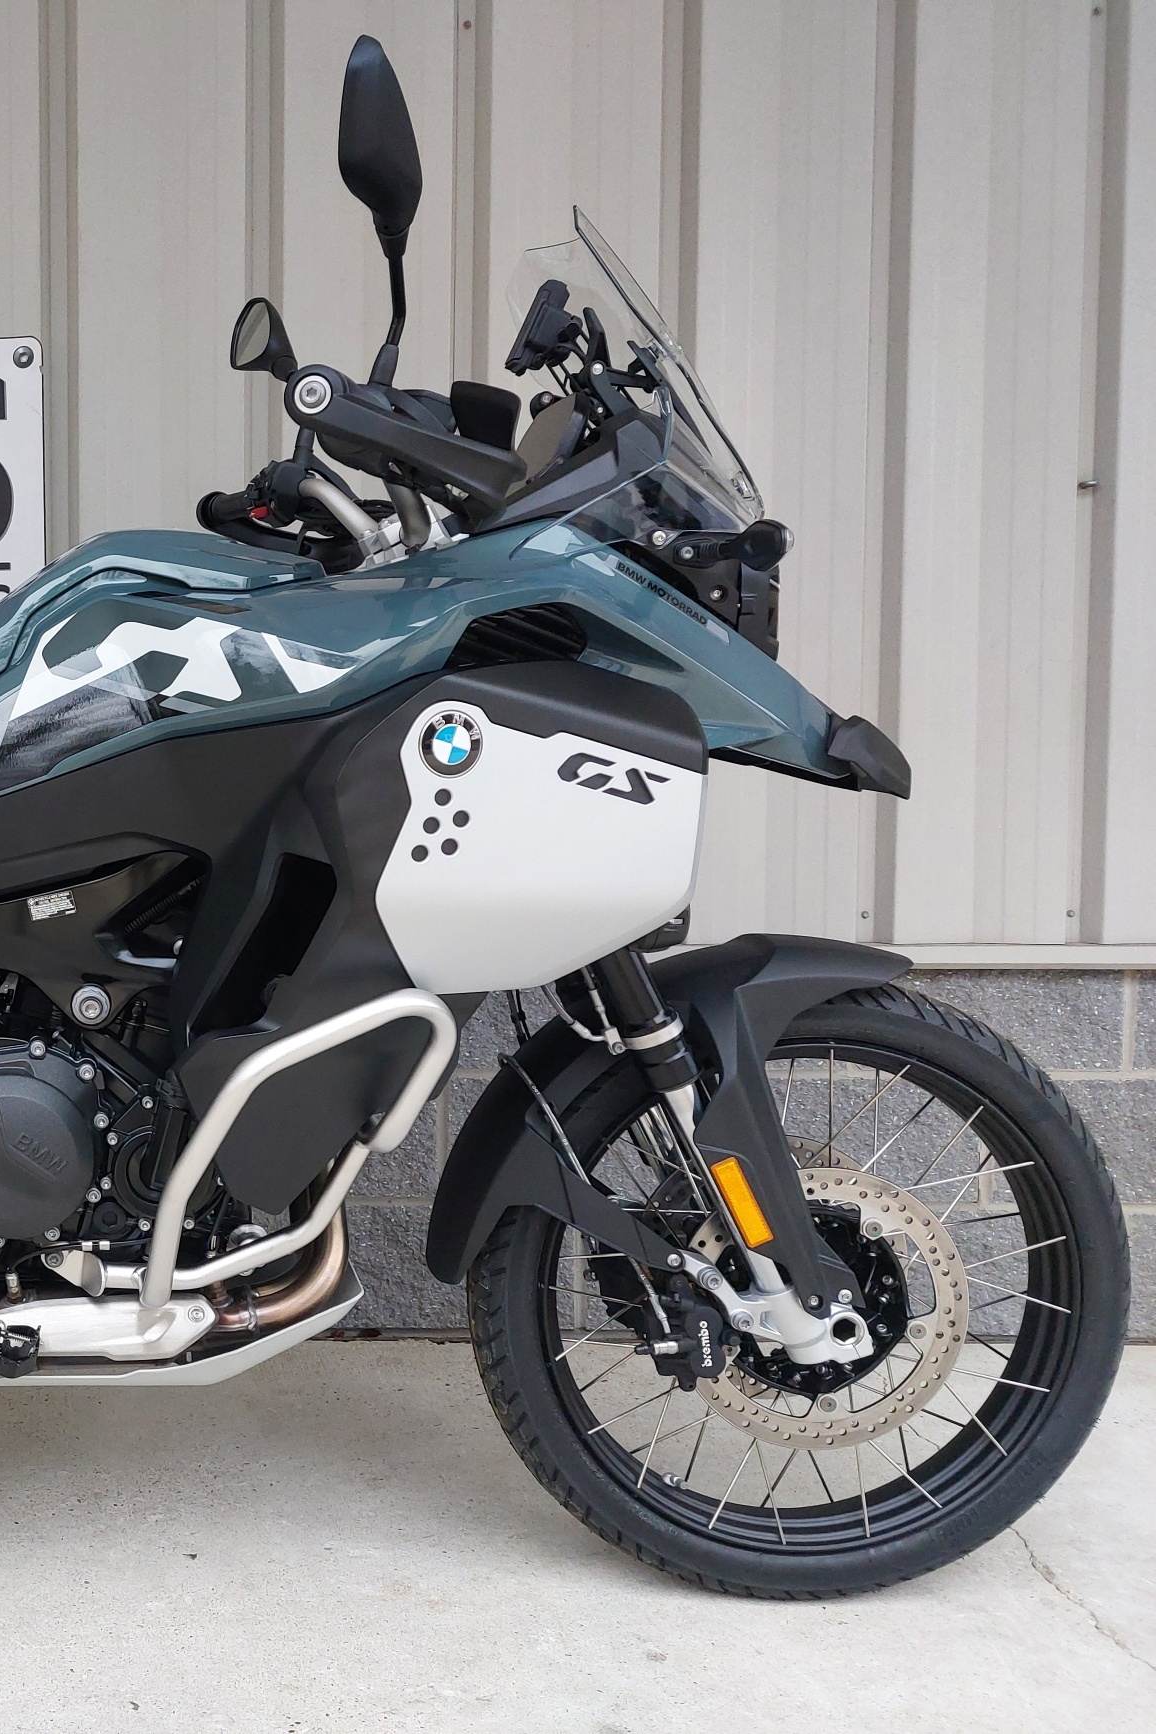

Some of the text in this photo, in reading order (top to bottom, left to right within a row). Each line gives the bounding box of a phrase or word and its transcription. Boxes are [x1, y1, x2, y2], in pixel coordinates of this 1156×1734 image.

[616, 560, 707, 626] BMW MOTORRAD
[433, 713, 481, 740] BMW
[557, 752, 672, 805] GS
[12, 1132, 67, 1174] BMW
[697, 1320, 713, 1368] brembo
